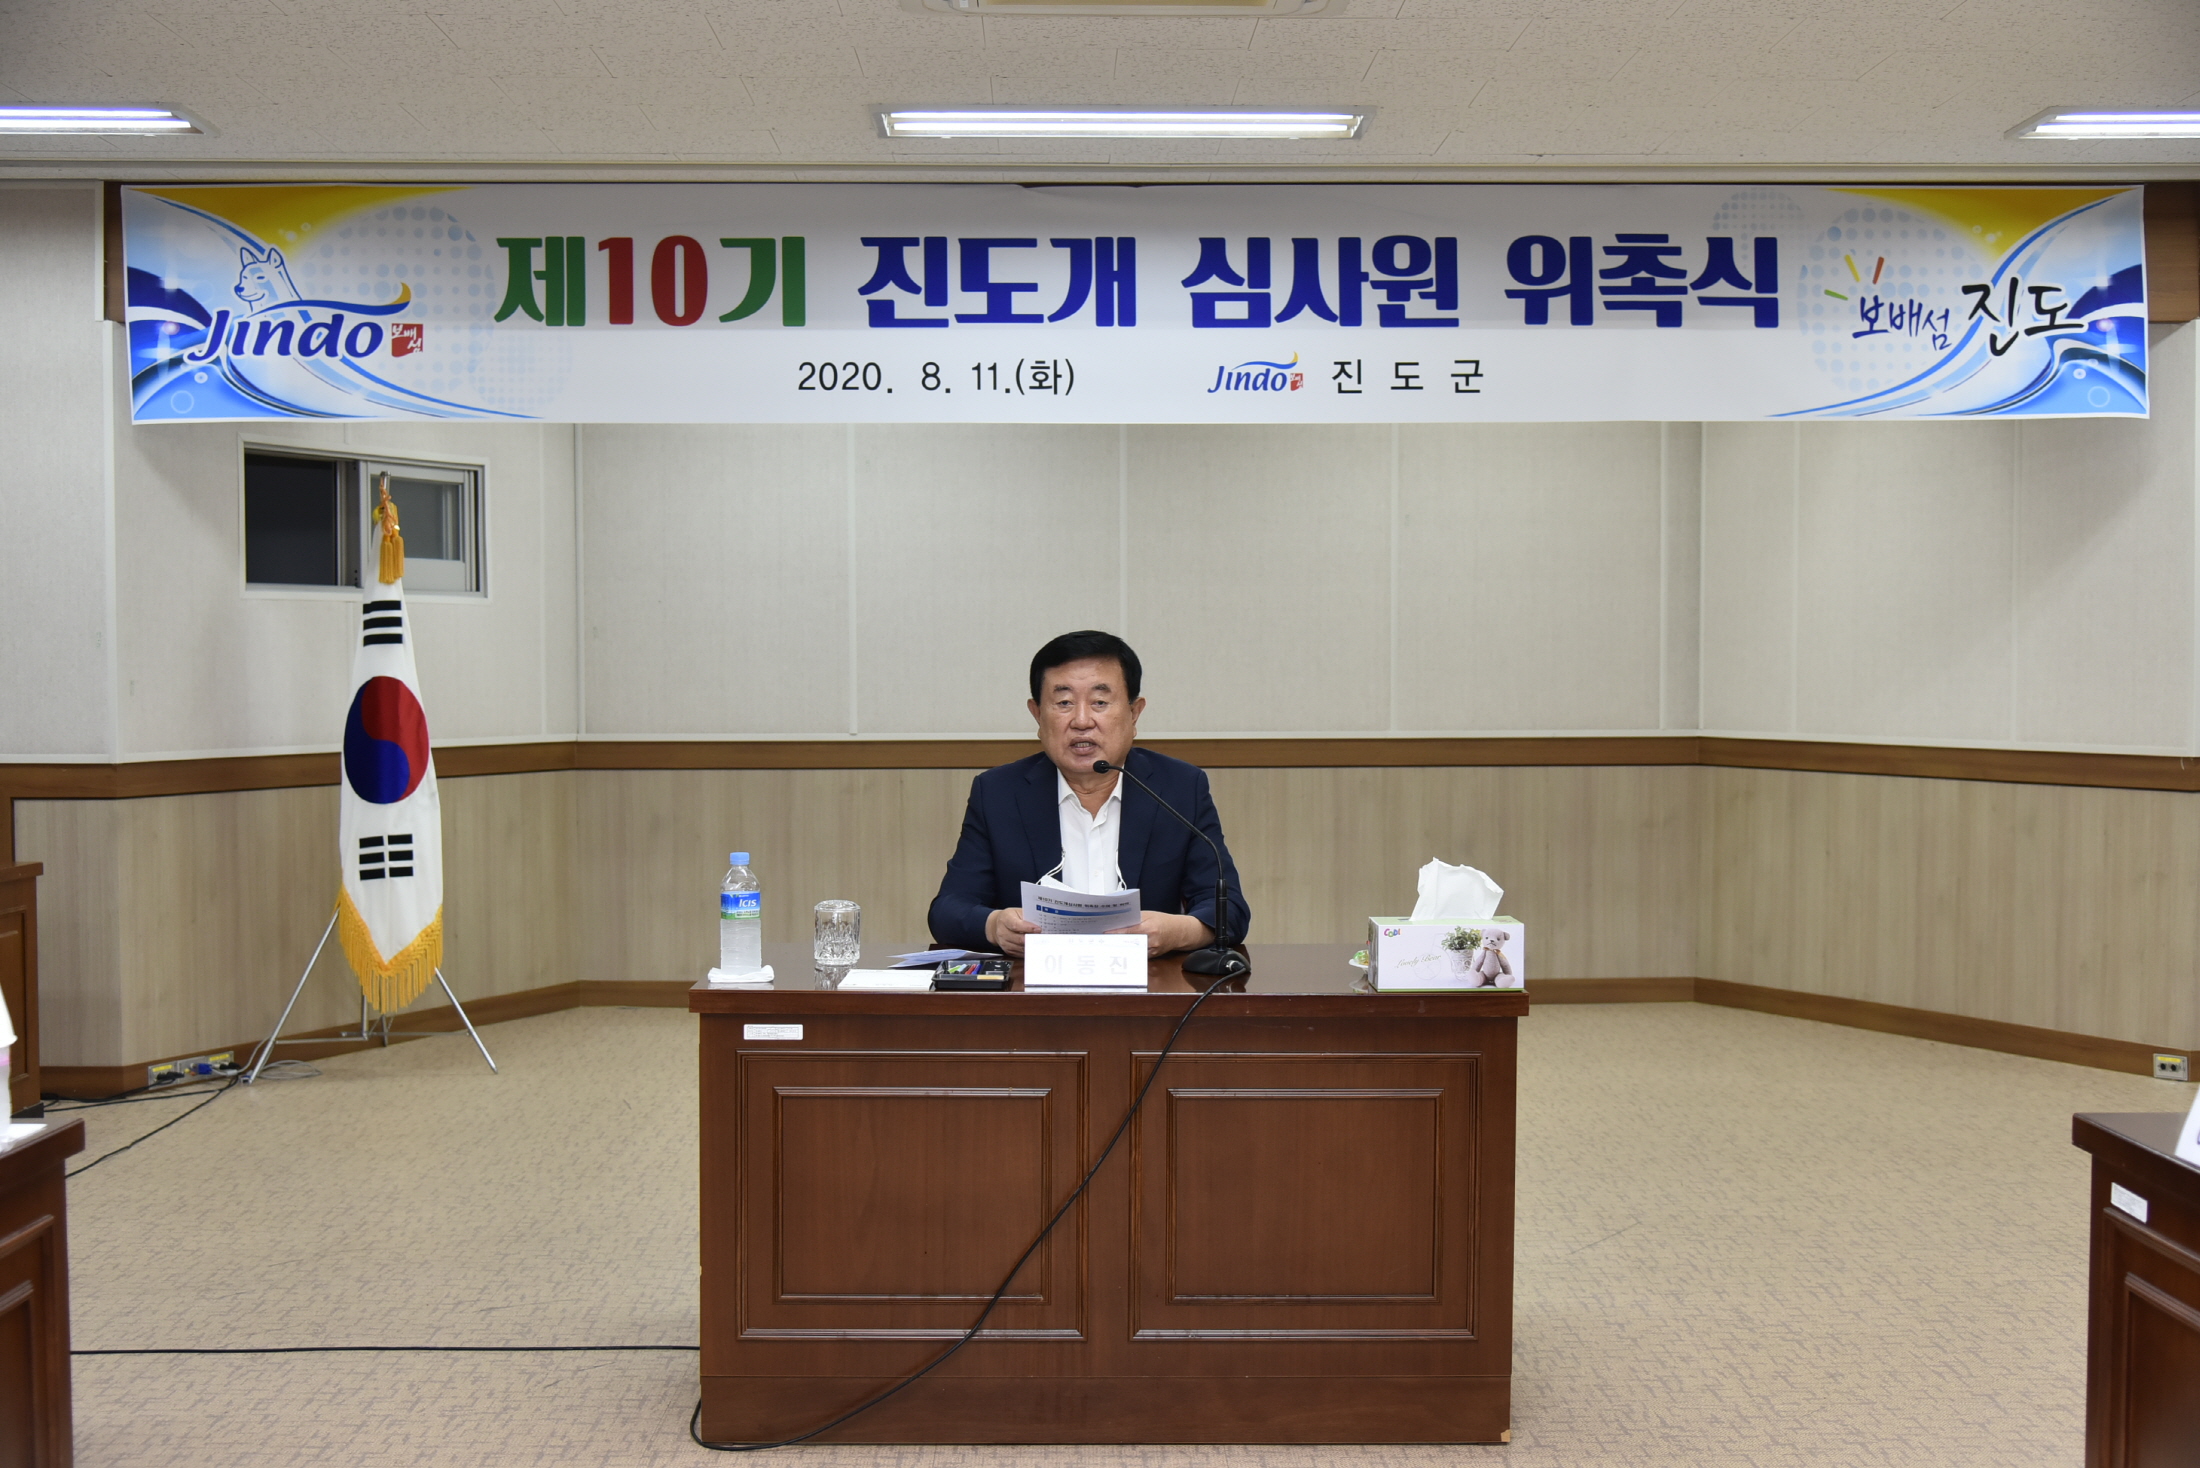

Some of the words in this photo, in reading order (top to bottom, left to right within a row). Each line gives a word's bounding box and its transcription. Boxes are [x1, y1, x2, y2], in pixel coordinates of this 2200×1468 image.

[494, 234, 806, 327] 제10기
[857, 236, 1137, 328] 진도개
[1181, 234, 1460, 328] 심사원
[1504, 233, 1779, 329] 위촉식
[186, 309, 384, 361] Jindo
[1852, 294, 1953, 351] 보배섬
[1961, 276, 2084, 356] 진도
[798, 361, 893, 394] 2020.
[921, 361, 951, 394] 8.
[1207, 365, 1287, 393] Jindo
